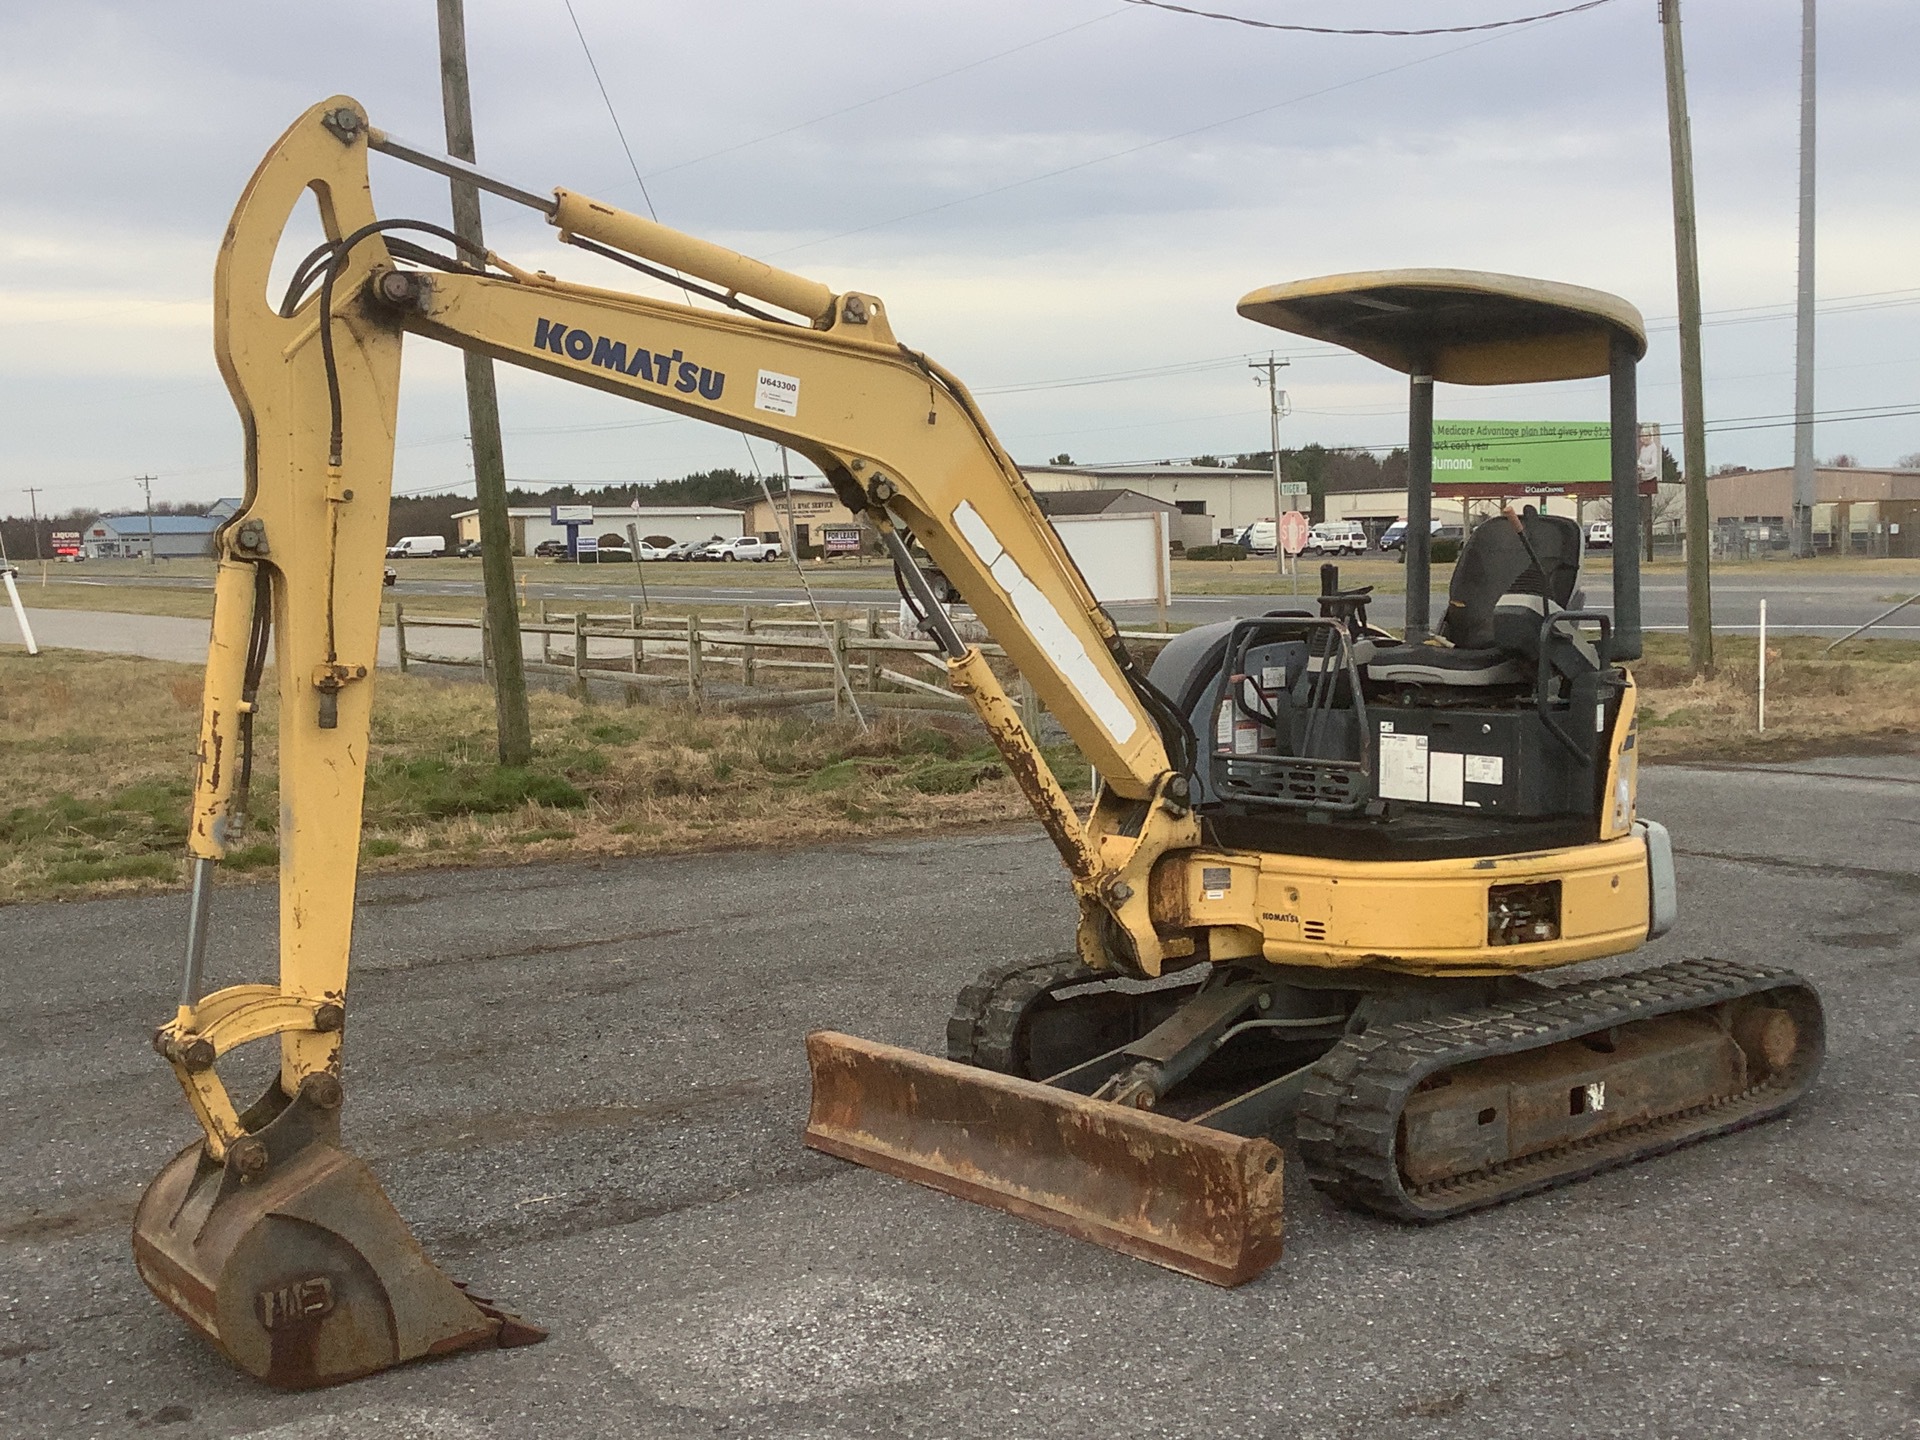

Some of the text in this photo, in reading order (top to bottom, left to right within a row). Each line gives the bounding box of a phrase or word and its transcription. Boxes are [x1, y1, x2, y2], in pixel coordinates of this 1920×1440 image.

[534, 318, 725, 400] KOMATSU
[760, 376, 797, 391] U643300
[1437, 425, 1475, 436] Medicare
[1476, 426, 1519, 437] Advantage
[1521, 426, 1538, 437] plan
[1540, 426, 1557, 436] that
[1558, 426, 1578, 438] gives
[1579, 427, 1593, 438] you
[1432, 440, 1448, 451] ack
[828, 532, 857, 540] FOR LEASE
[1281, 525, 1304, 539] SP
